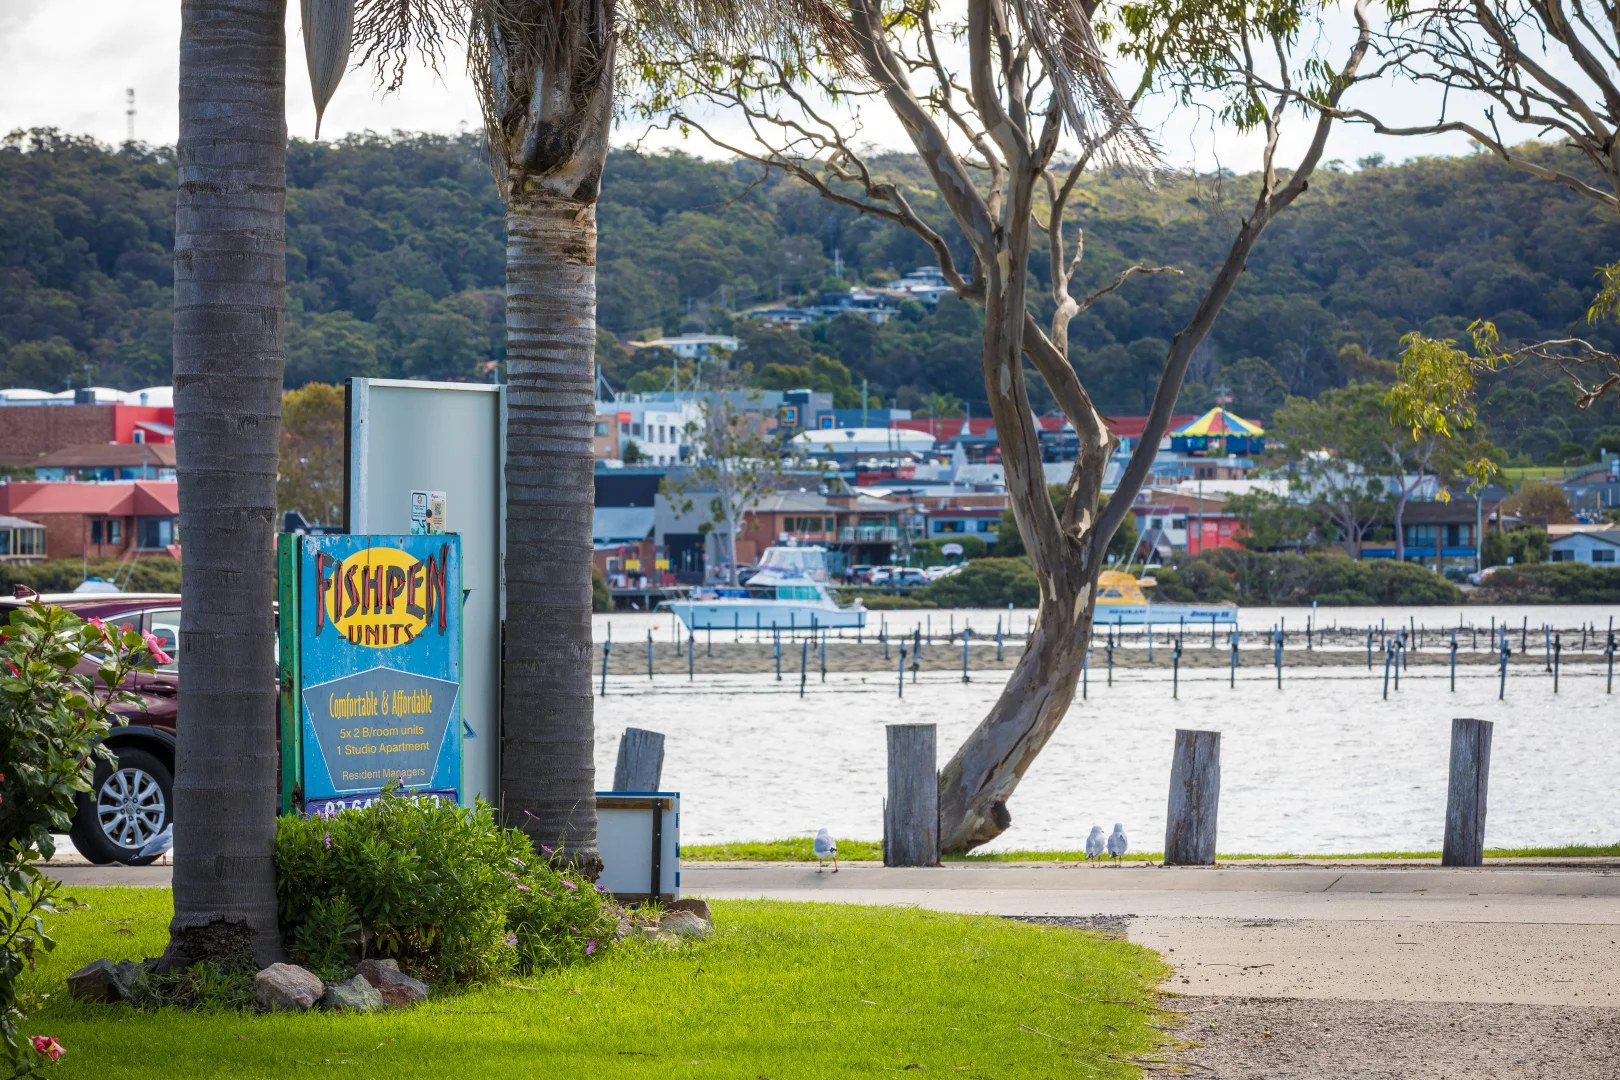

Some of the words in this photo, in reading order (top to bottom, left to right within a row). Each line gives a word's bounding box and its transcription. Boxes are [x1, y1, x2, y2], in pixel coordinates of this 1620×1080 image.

[316, 542, 450, 637] FISHPEN
[329, 691, 378, 719] Comfortable
[381, 690, 389, 716] &
[391, 689, 433, 716] Affordable
[339, 728, 351, 739] 5x
[353, 728, 360, 738] 2
[362, 726, 398, 738] B/room
[401, 725, 424, 736] units
[337, 746, 341, 755] 1
[344, 744, 376, 755] Studio
[379, 741, 430, 755] Apartment
[342, 770, 380, 780] Resident
[382, 768, 425, 780] Managers
